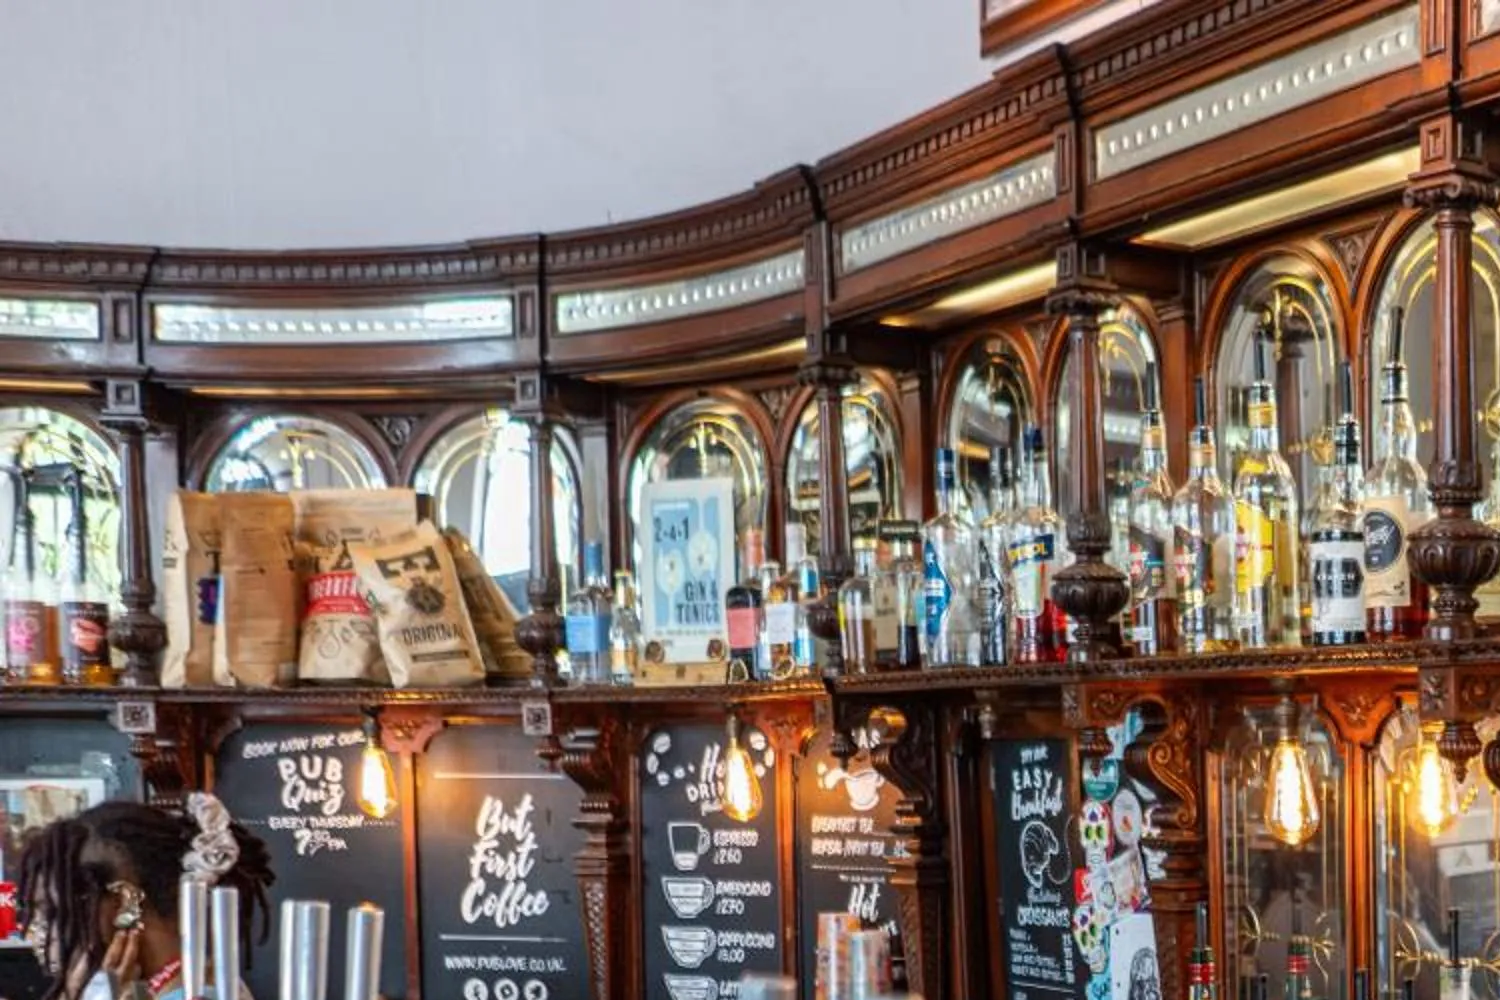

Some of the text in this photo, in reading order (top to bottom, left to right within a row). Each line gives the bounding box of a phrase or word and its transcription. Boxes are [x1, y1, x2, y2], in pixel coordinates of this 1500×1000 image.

[277, 754, 343, 782] PUB
[1012, 768, 1053, 791] EASY
[281, 772, 345, 816] Quiz
[268, 815, 365, 830] EVERY THURSDAY
[475, 792, 536, 842] But
[469, 832, 539, 882] First
[460, 877, 549, 928] Coffee
[848, 882, 882, 922] Hot
